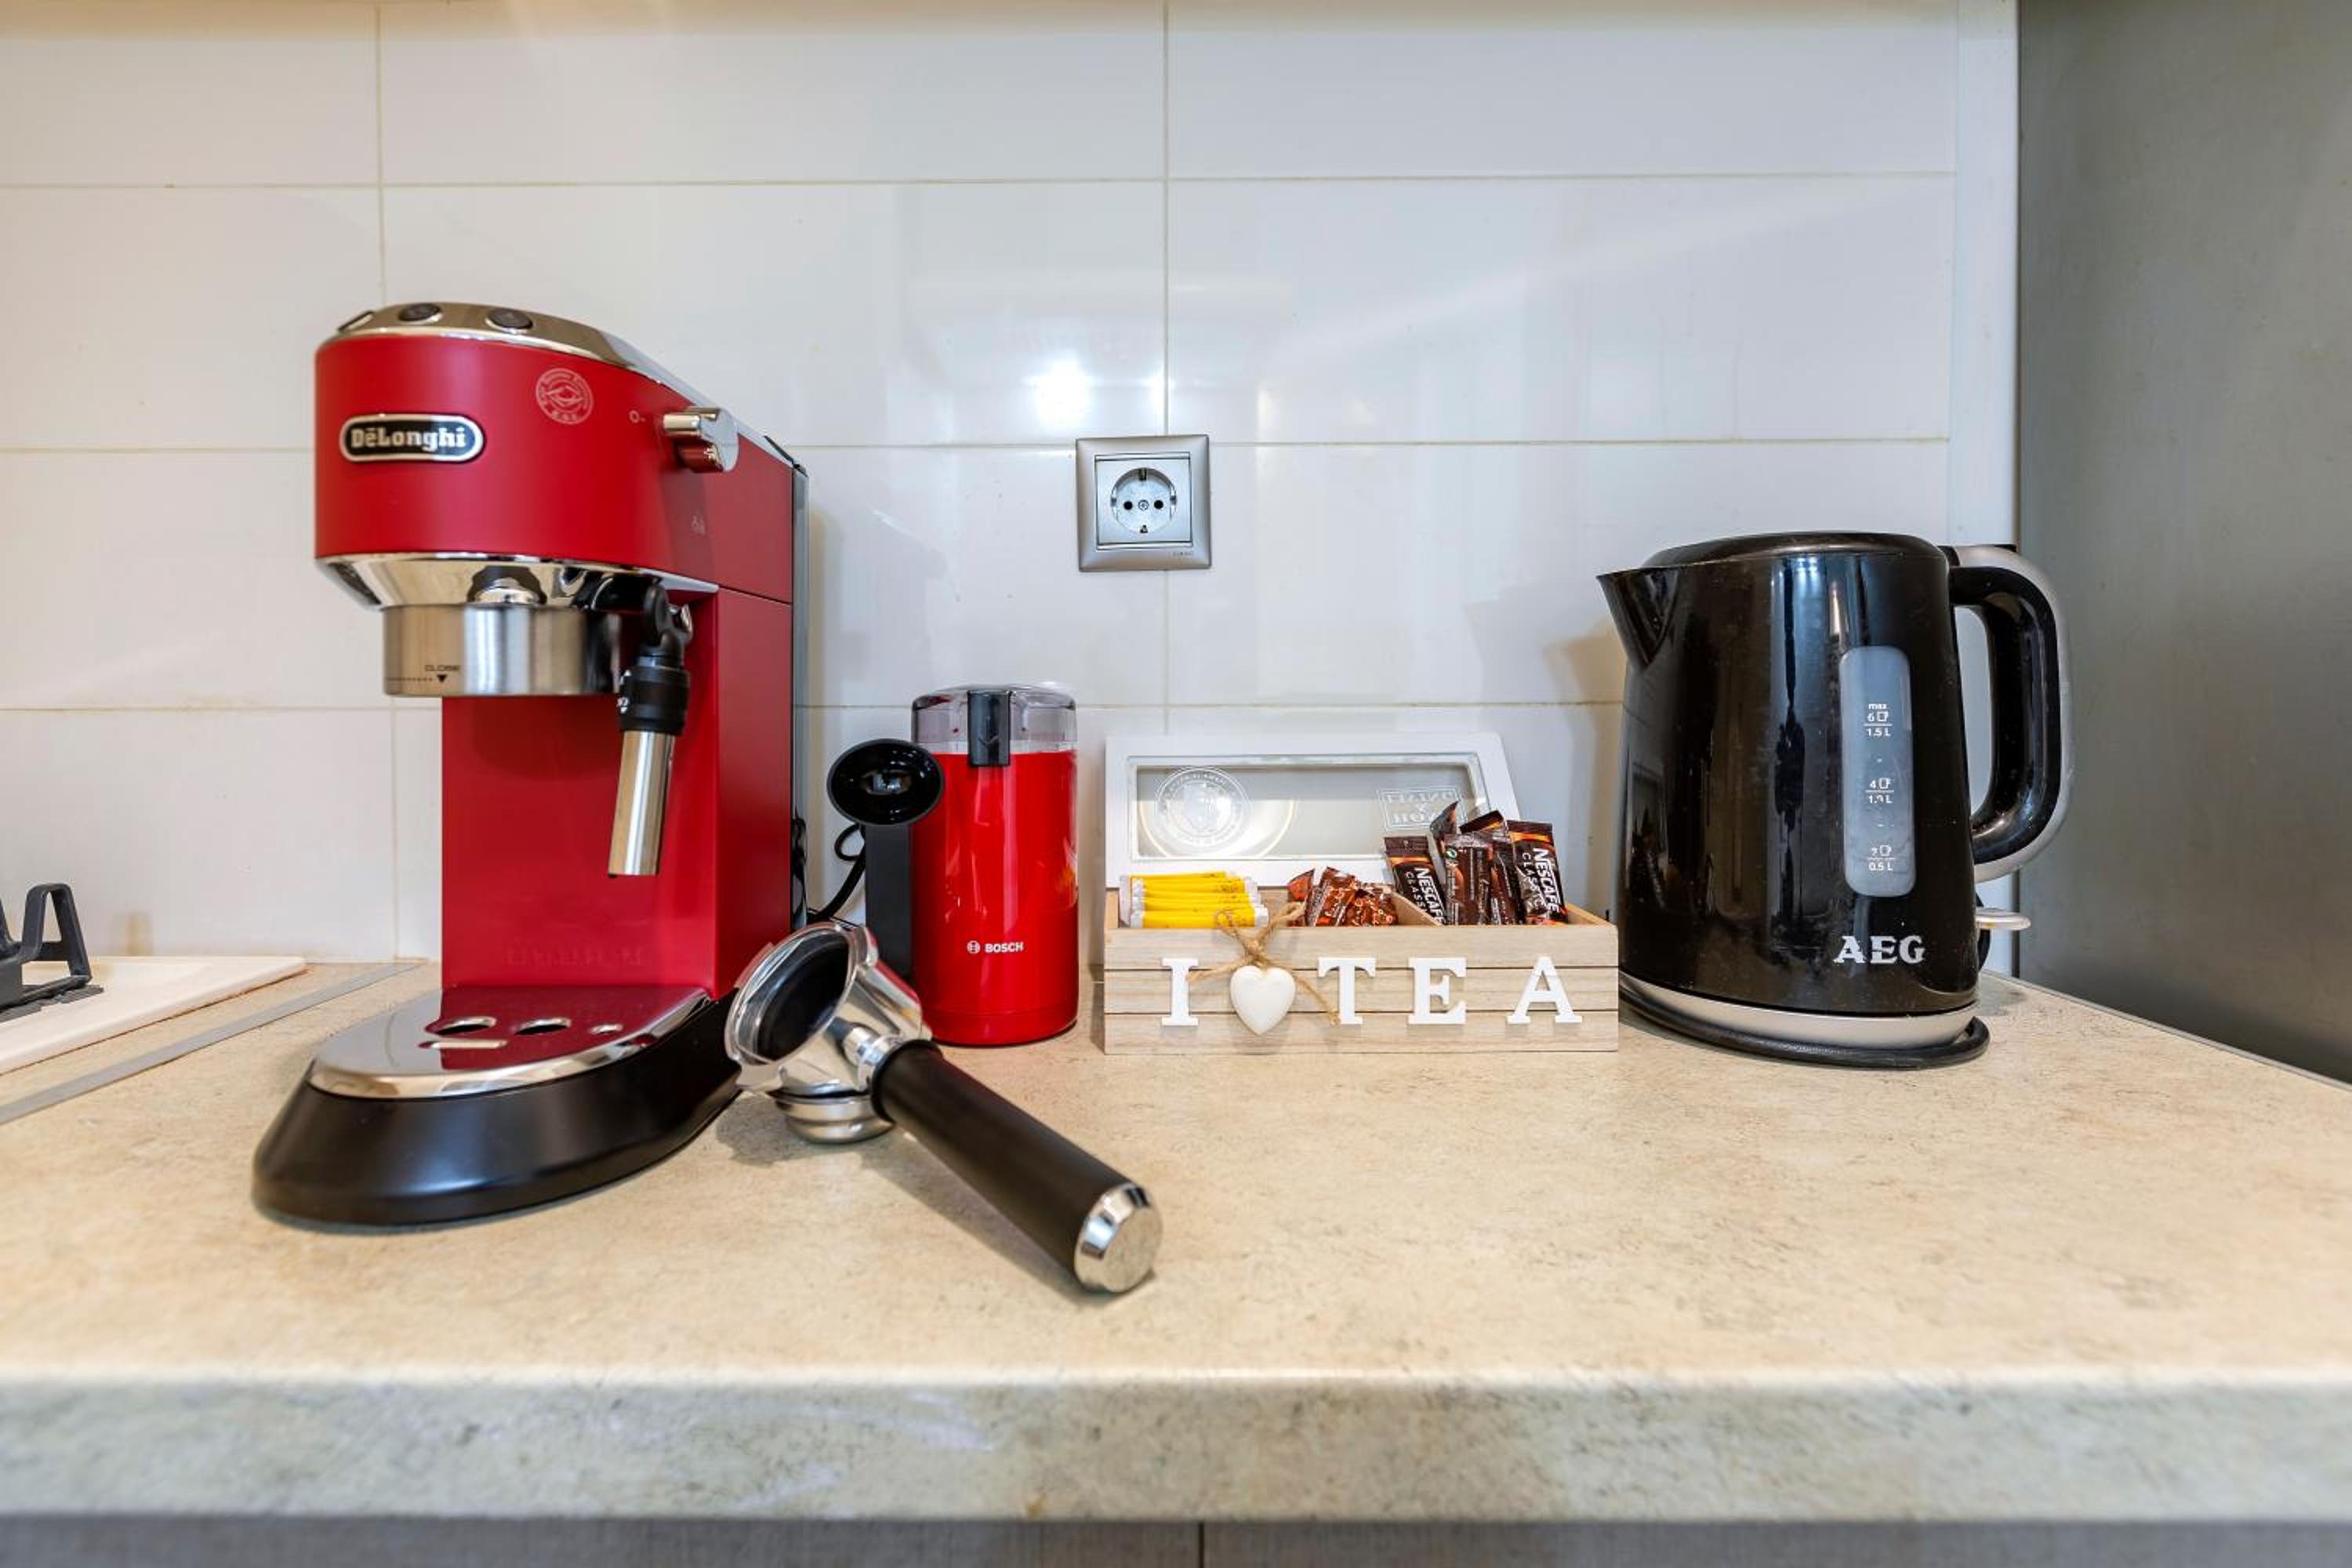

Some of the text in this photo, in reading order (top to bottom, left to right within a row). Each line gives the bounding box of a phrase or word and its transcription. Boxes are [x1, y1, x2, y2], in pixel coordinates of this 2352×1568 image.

[1867, 711, 1875, 722] 6
[984, 942, 1025, 953] BOSCH
[1833, 935, 1926, 964] AEG
[1162, 956, 1582, 1026] I TEA
